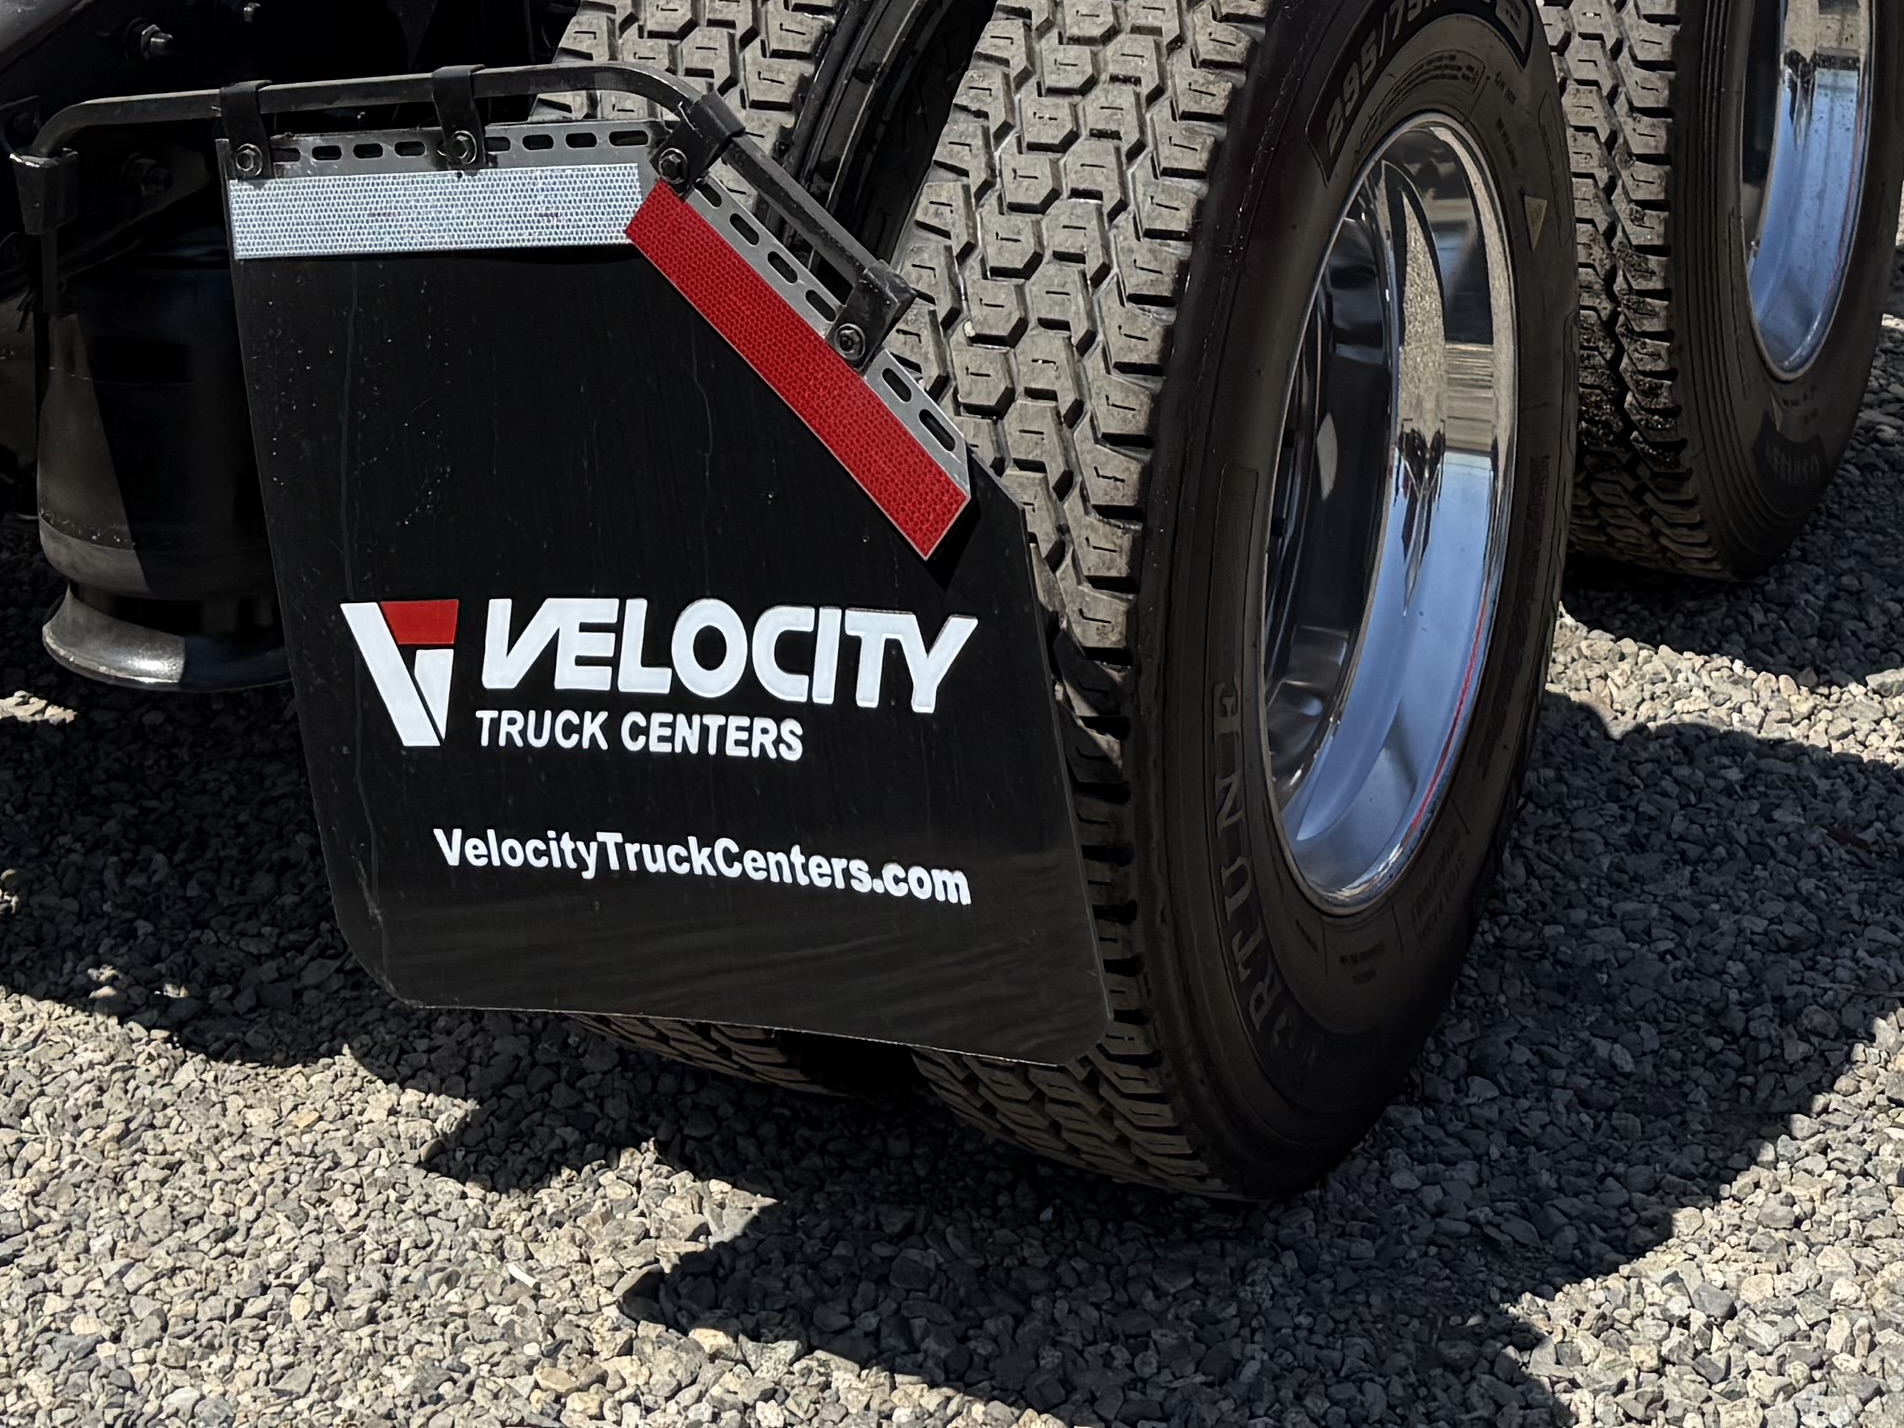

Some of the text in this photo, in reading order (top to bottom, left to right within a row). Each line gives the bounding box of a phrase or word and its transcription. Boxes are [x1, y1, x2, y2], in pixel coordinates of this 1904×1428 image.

[481, 597, 978, 714] VELOCITY
[475, 709, 804, 762] TRUCK CENTERS
[433, 828, 972, 906] VelocityTruckCenters.com
